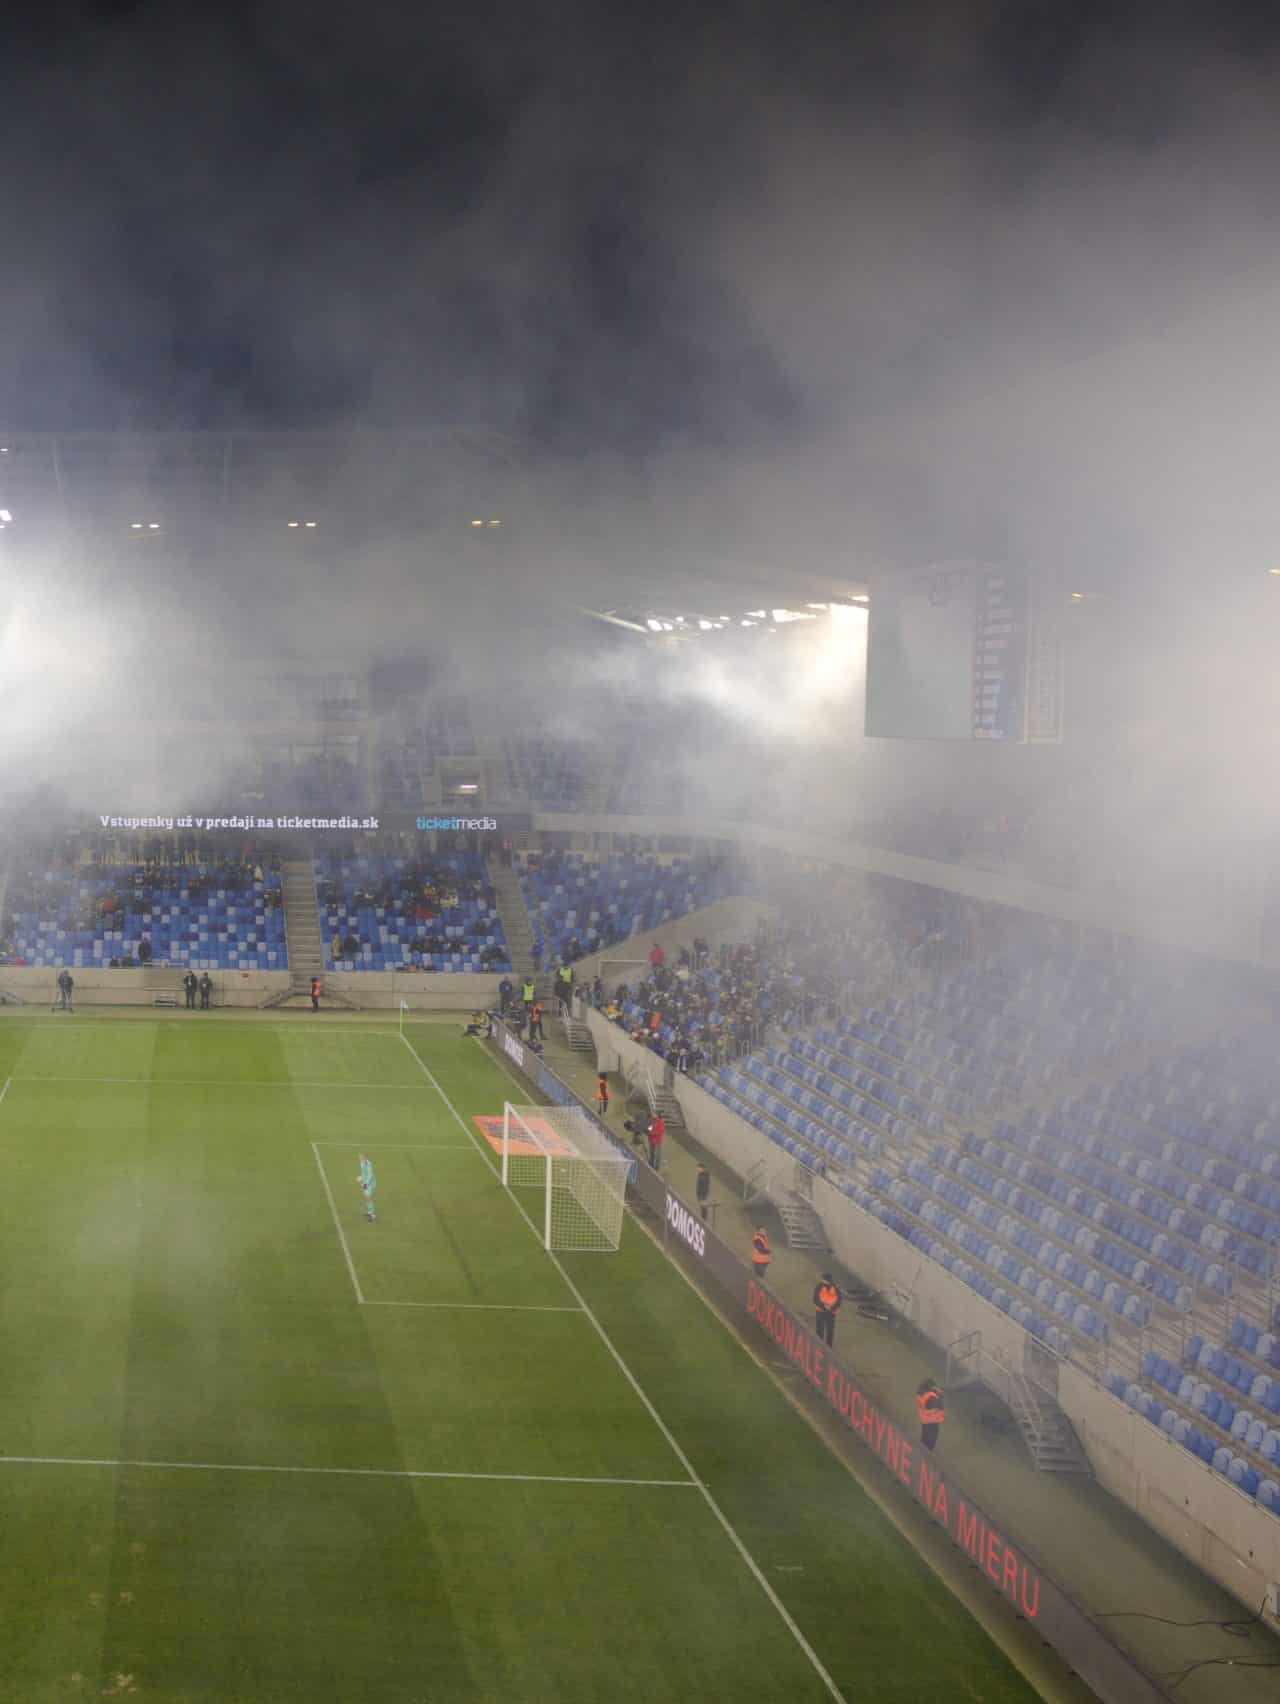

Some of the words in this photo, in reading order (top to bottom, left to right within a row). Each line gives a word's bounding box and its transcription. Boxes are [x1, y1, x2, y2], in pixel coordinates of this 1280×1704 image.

[100, 816, 173, 829] Vstupenky
[177, 815, 192, 827] už
[195, 818, 204, 827] v
[206, 816, 254, 830] predaji
[258, 818, 273, 828] na
[277, 816, 379, 828] ticketmedia.sk
[416, 816, 496, 830] ticketmedia
[827, 1366, 913, 1485] KUCHYNE
[920, 1462, 949, 1525] NA
[958, 1503, 1040, 1616] MIERU
